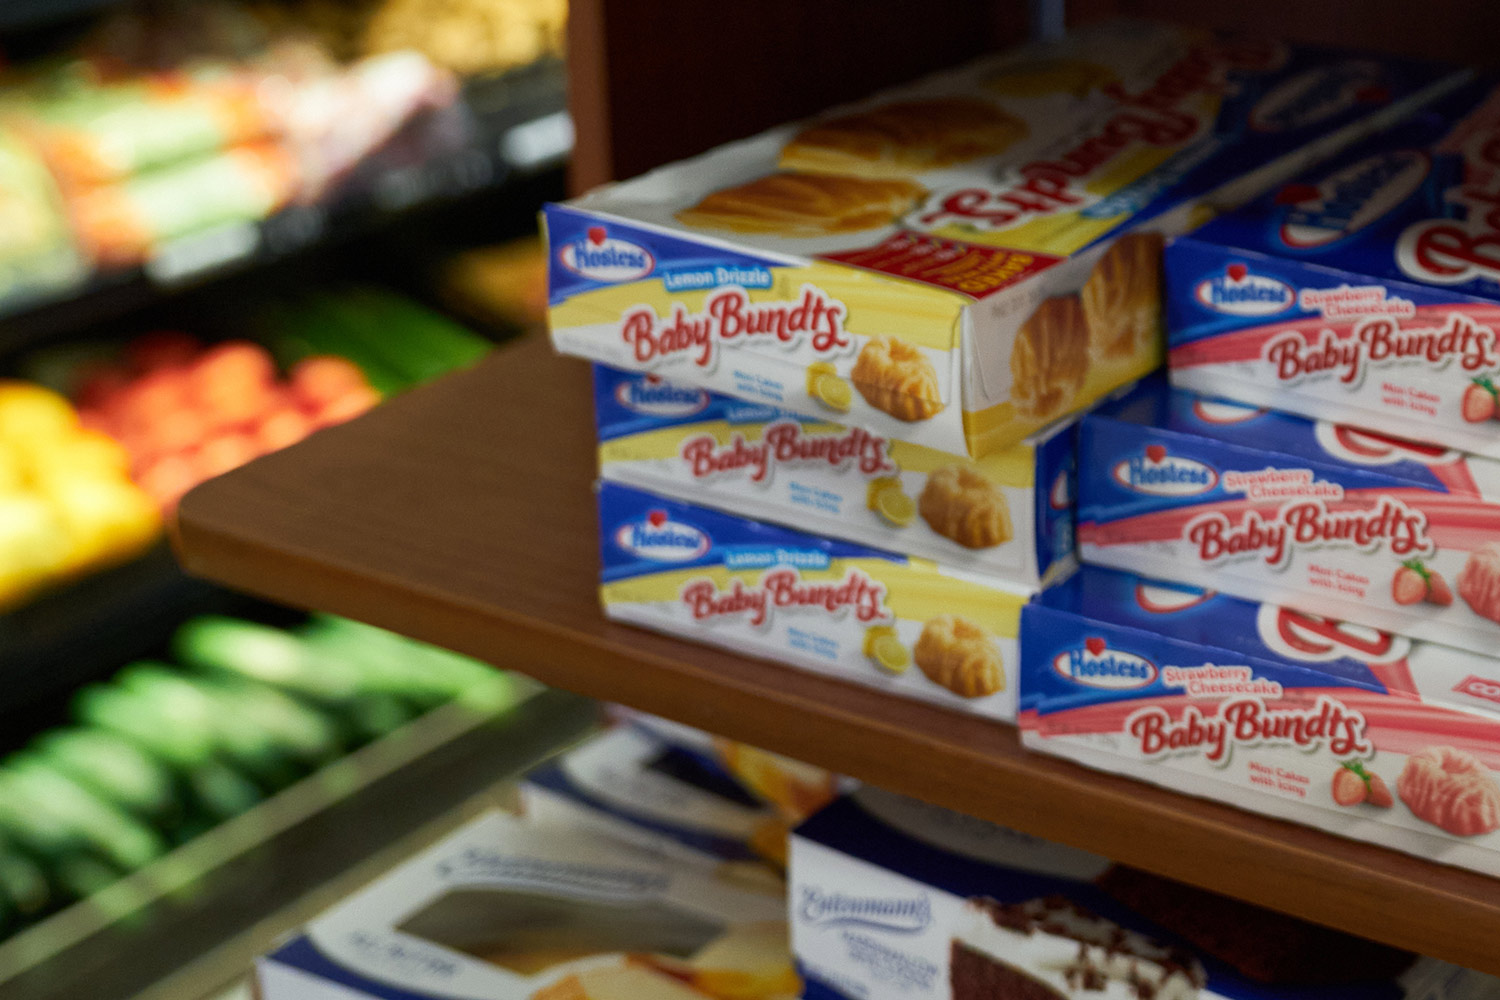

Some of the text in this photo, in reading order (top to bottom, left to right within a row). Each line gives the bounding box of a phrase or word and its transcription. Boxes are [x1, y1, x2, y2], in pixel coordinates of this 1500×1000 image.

[574, 242, 647, 270] Hostess
[666, 267, 770, 287] Lemon Drizzle
[1210, 278, 1287, 304] Hostess
[1304, 287, 1384, 308] Strawberry
[1325, 300, 1412, 317] Cheesecake
[623, 289, 849, 367] Baby Bundts
[1269, 318, 1496, 383] Baby Bundts
[683, 423, 893, 481] Baby Bundts
[1129, 458, 1209, 485] Hostess
[1227, 471, 1311, 491] Strawberry
[1250, 483, 1342, 499] Cheesecake
[1190, 502, 1429, 565] Baby Bundts
[683, 571, 889, 626] Baby Bundts
[1070, 649, 1149, 680] Hostess
[1164, 665, 1250, 684] Strawberry
[1187, 679, 1280, 696] Cheesecake
[1131, 712, 1226, 761] Baby
[1225, 700, 1368, 756] Bundts
